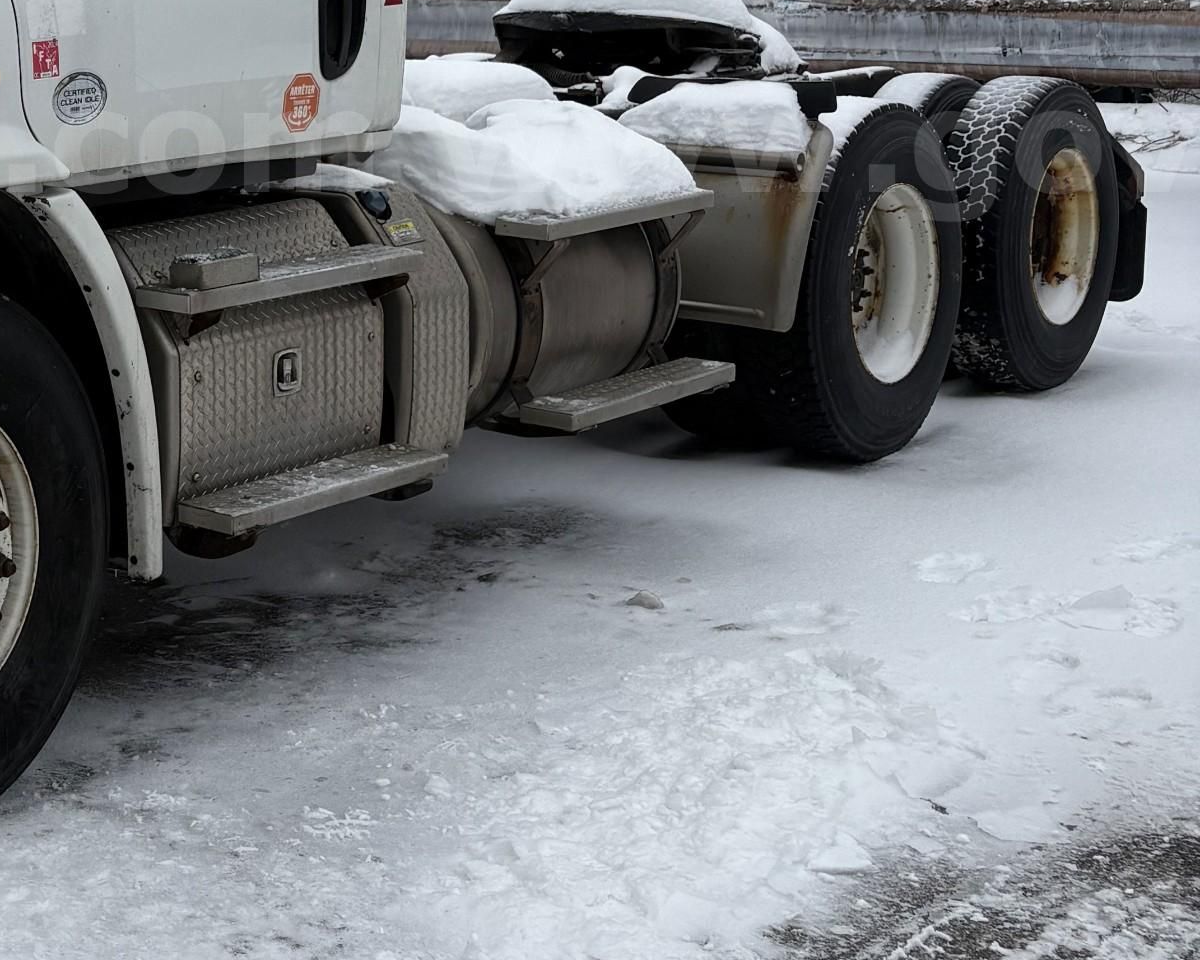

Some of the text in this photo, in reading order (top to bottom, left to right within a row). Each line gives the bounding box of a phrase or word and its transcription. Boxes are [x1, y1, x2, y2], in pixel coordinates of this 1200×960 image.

[64, 87, 97, 97] CERTIFIED
[61, 95, 100, 107] CLEAN IDLE
